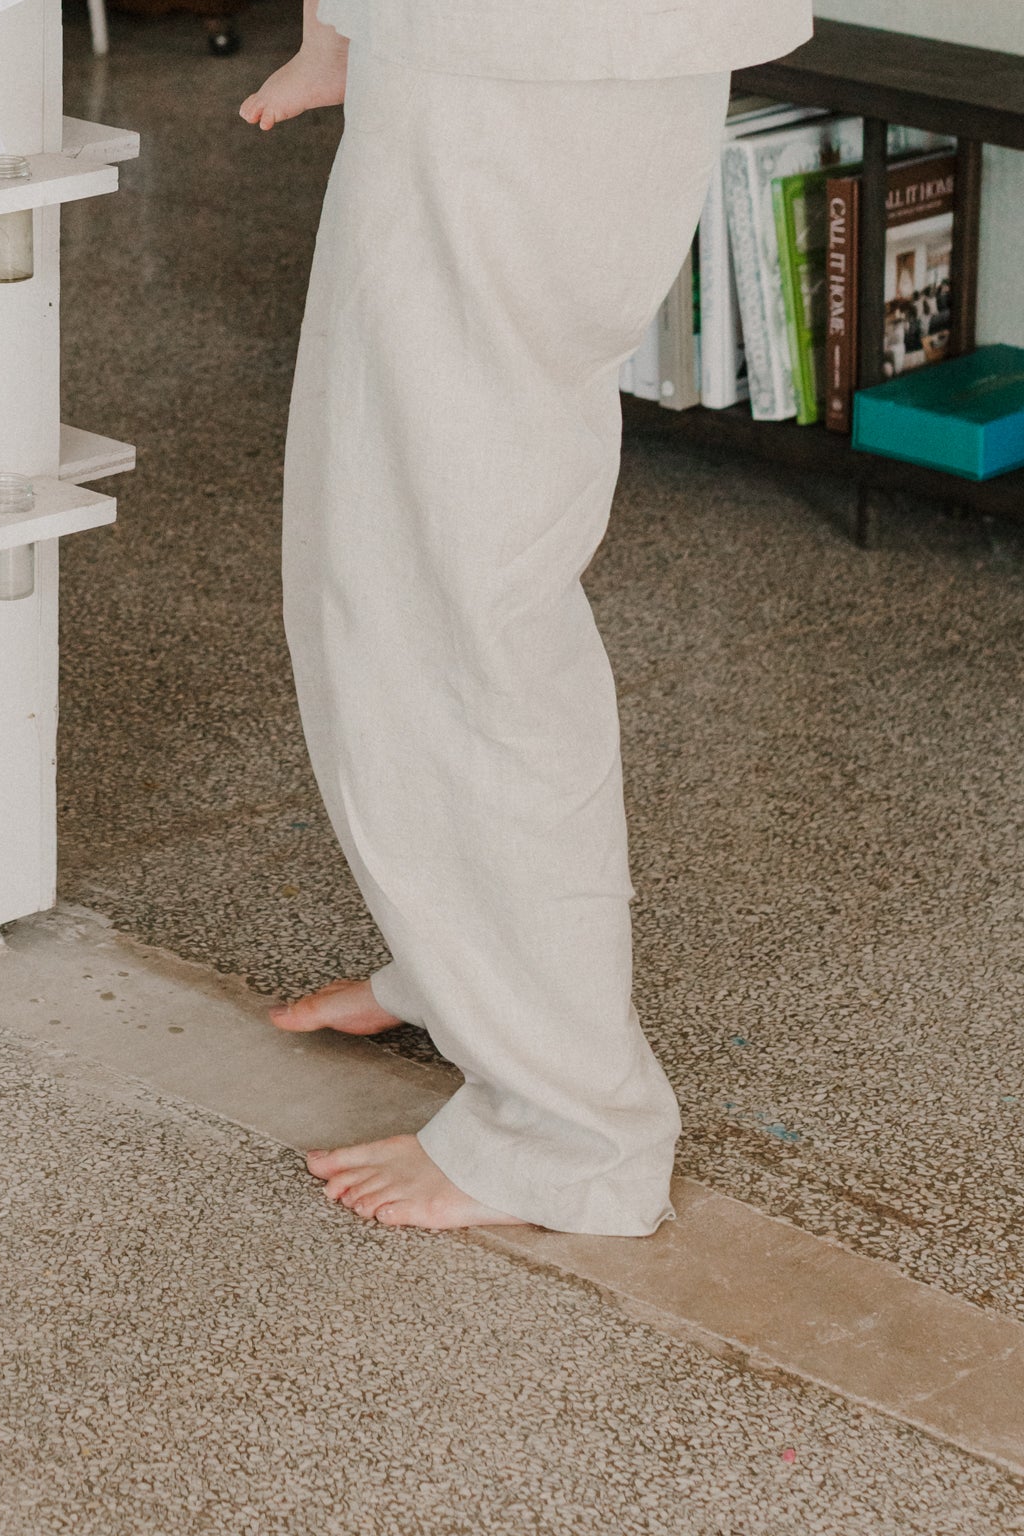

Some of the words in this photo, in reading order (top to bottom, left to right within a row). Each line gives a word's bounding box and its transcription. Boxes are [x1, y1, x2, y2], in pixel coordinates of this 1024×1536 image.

[829, 197, 846, 249] CALL
[829, 252, 846, 273] IT
[829, 275, 846, 336] HOME
